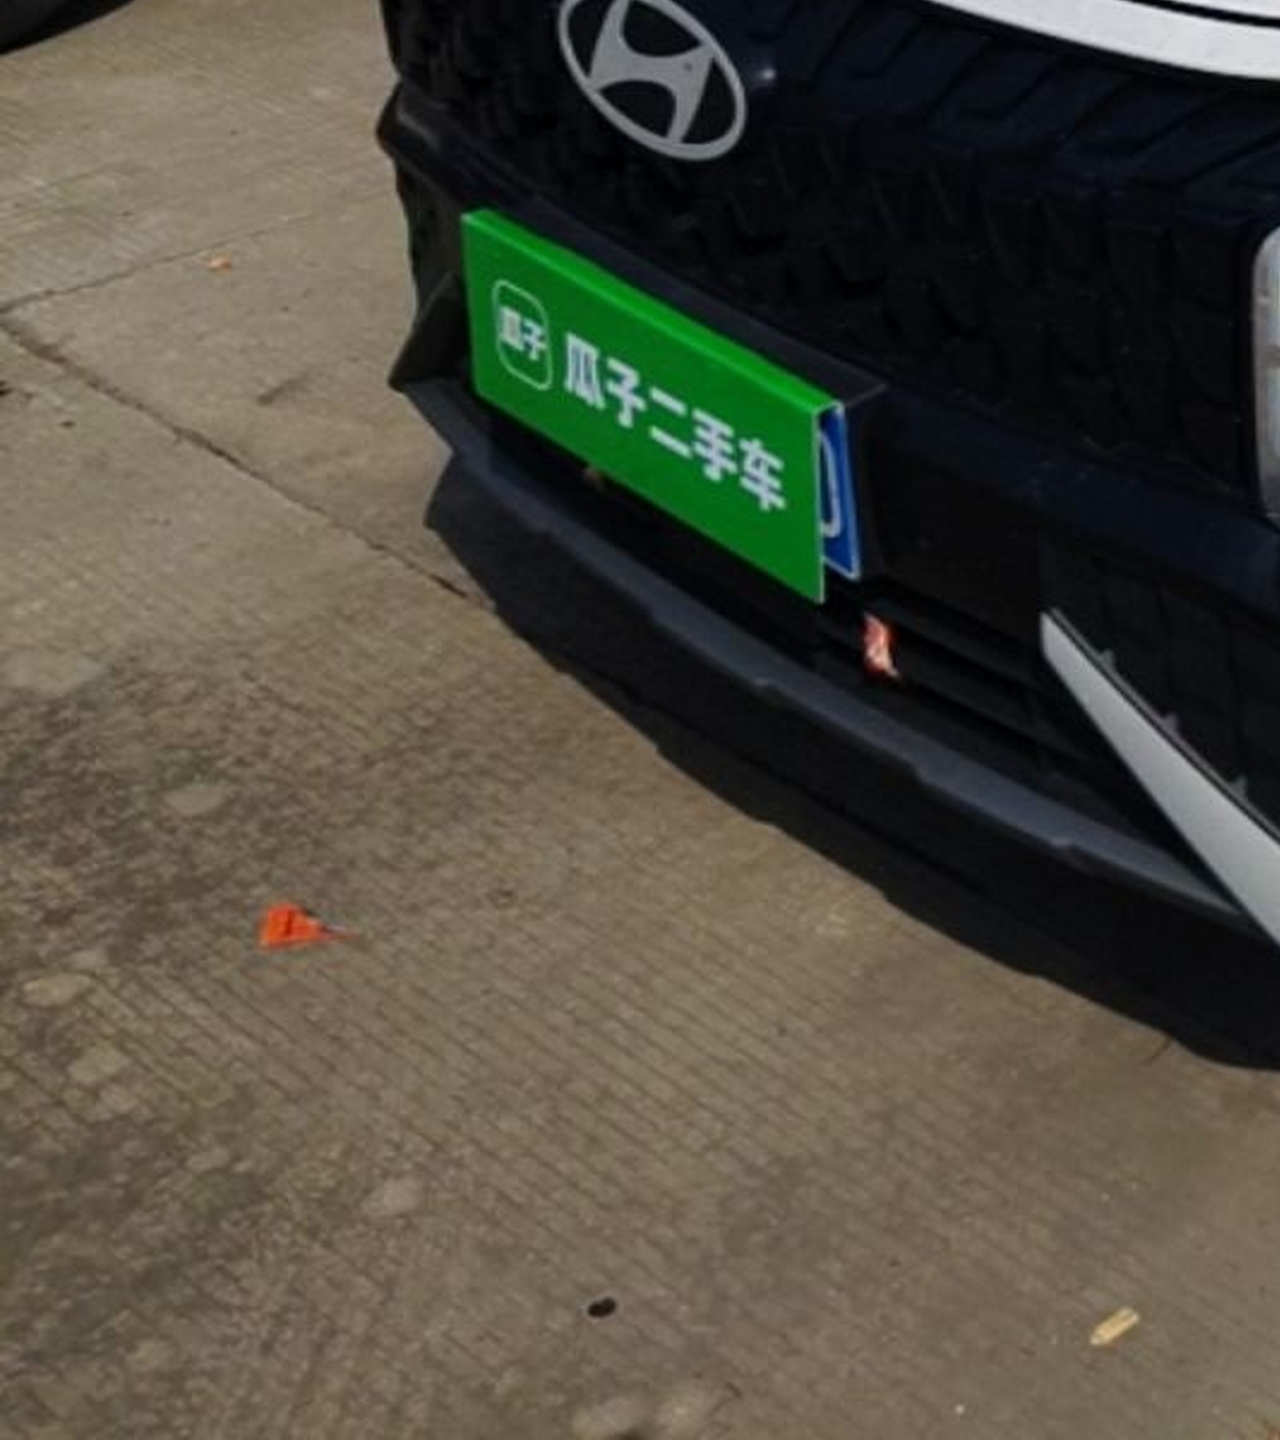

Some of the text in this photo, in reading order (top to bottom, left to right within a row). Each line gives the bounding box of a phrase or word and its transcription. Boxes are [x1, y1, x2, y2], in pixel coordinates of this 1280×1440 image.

[564, 332, 786, 511] 瓜子二手车
